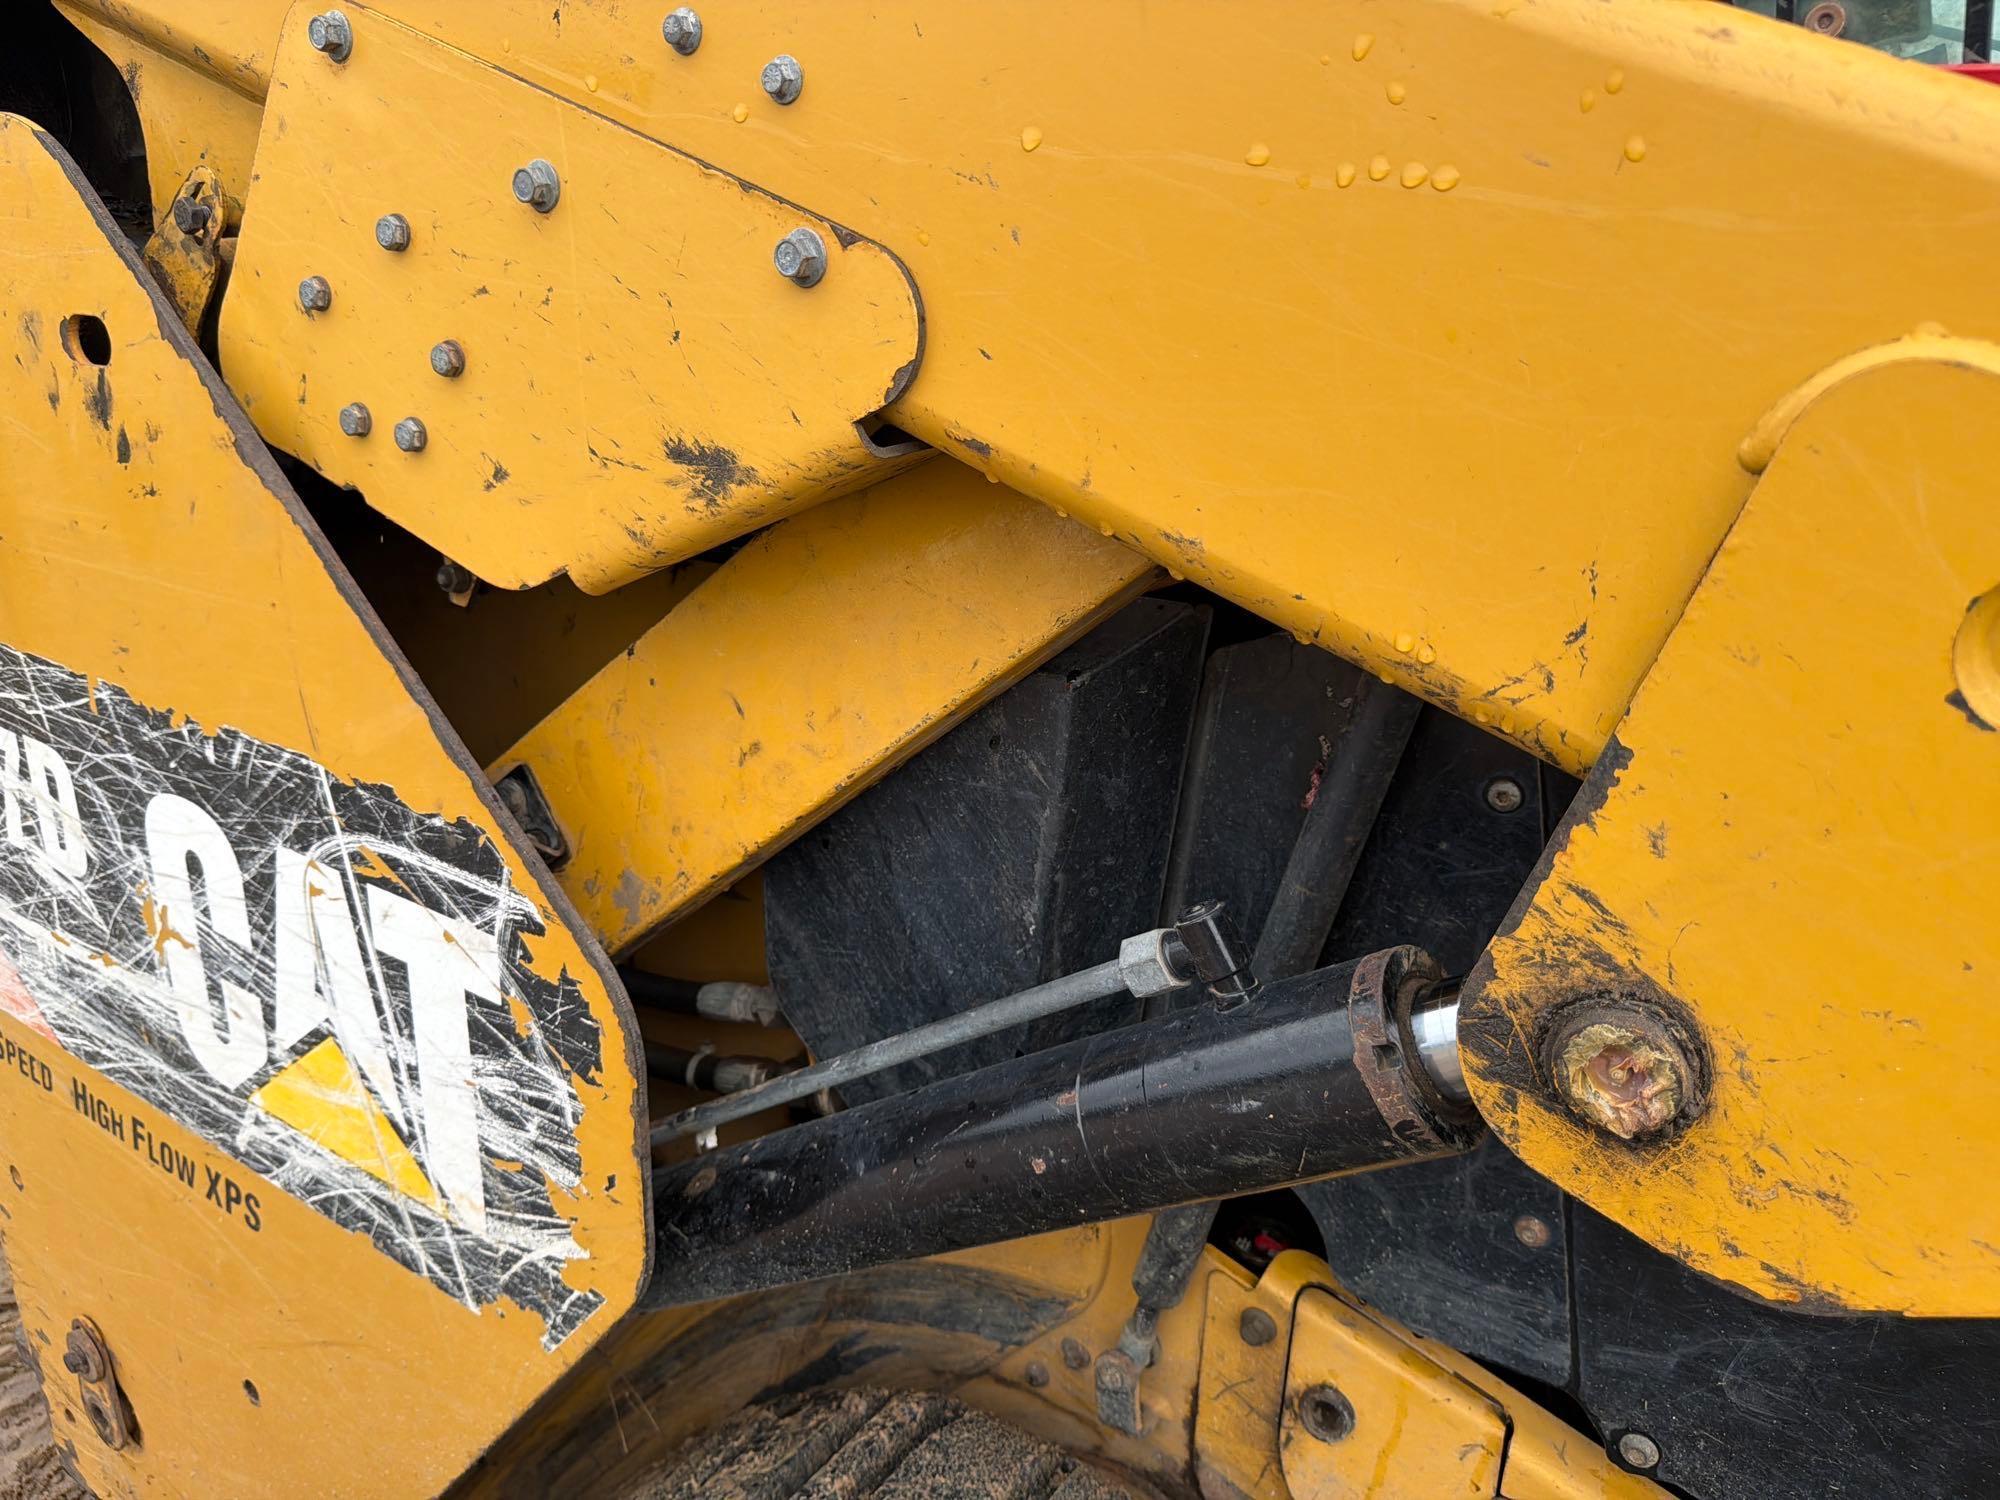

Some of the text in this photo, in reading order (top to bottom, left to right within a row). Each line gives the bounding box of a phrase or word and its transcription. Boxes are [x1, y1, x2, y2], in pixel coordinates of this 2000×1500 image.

[72, 1076, 125, 1142] HIGH
[131, 1115, 196, 1189] FLOW
[204, 1163, 262, 1232] XPS
[145, 793, 503, 1238] CAT
